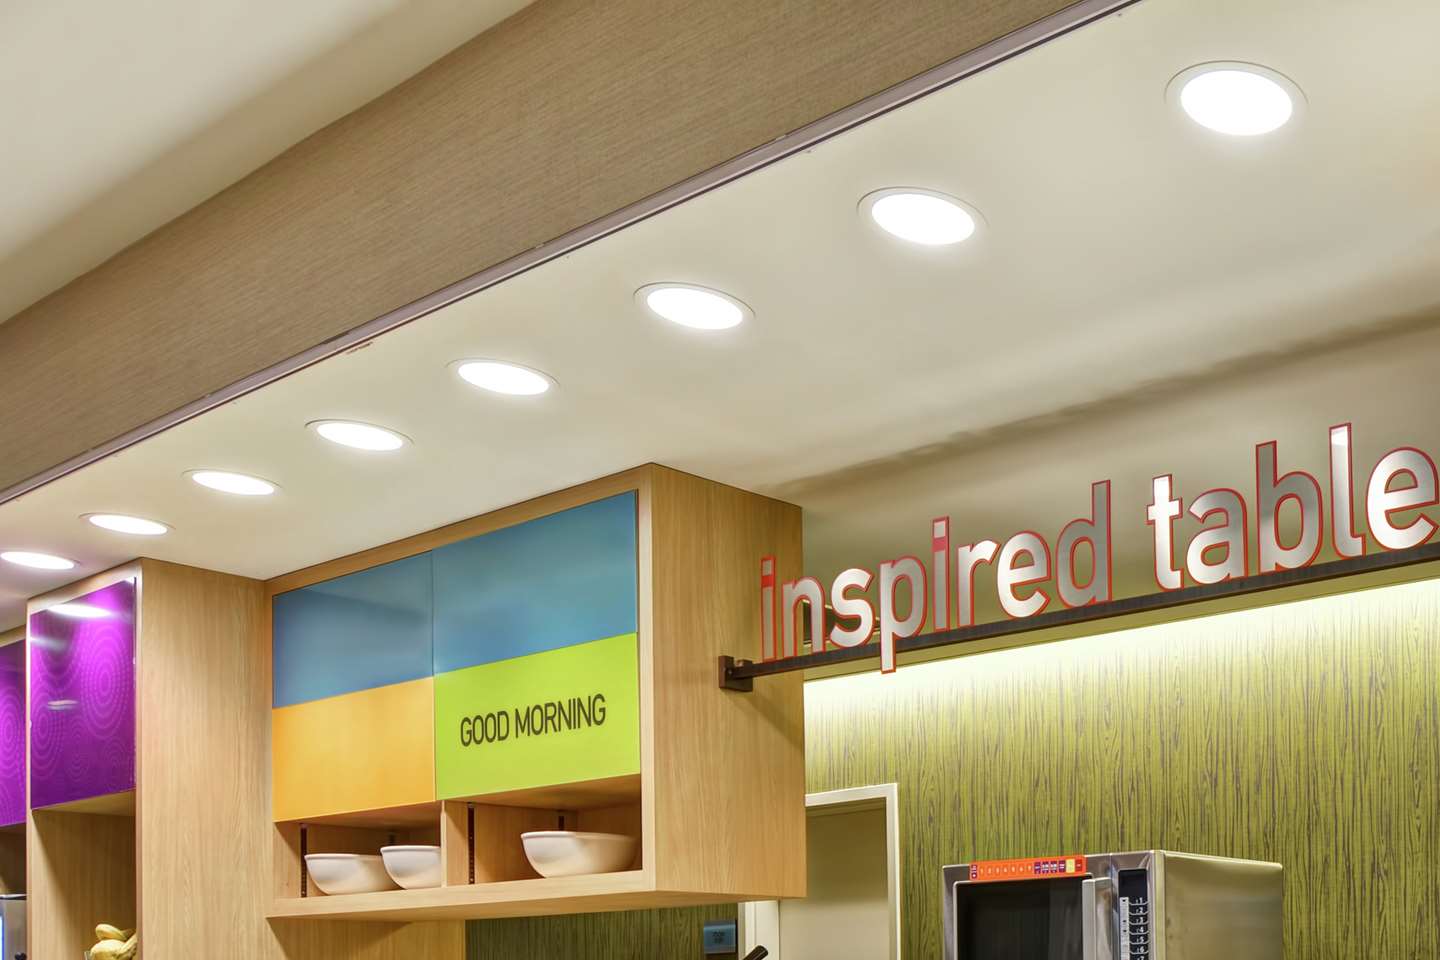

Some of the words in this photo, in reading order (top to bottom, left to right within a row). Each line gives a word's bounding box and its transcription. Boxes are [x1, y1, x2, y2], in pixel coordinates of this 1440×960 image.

[759, 479, 1112, 675] inspired
[1146, 422, 1440, 591] table
[460, 710, 510, 747] GOOD
[514, 693, 606, 739] MORNING
